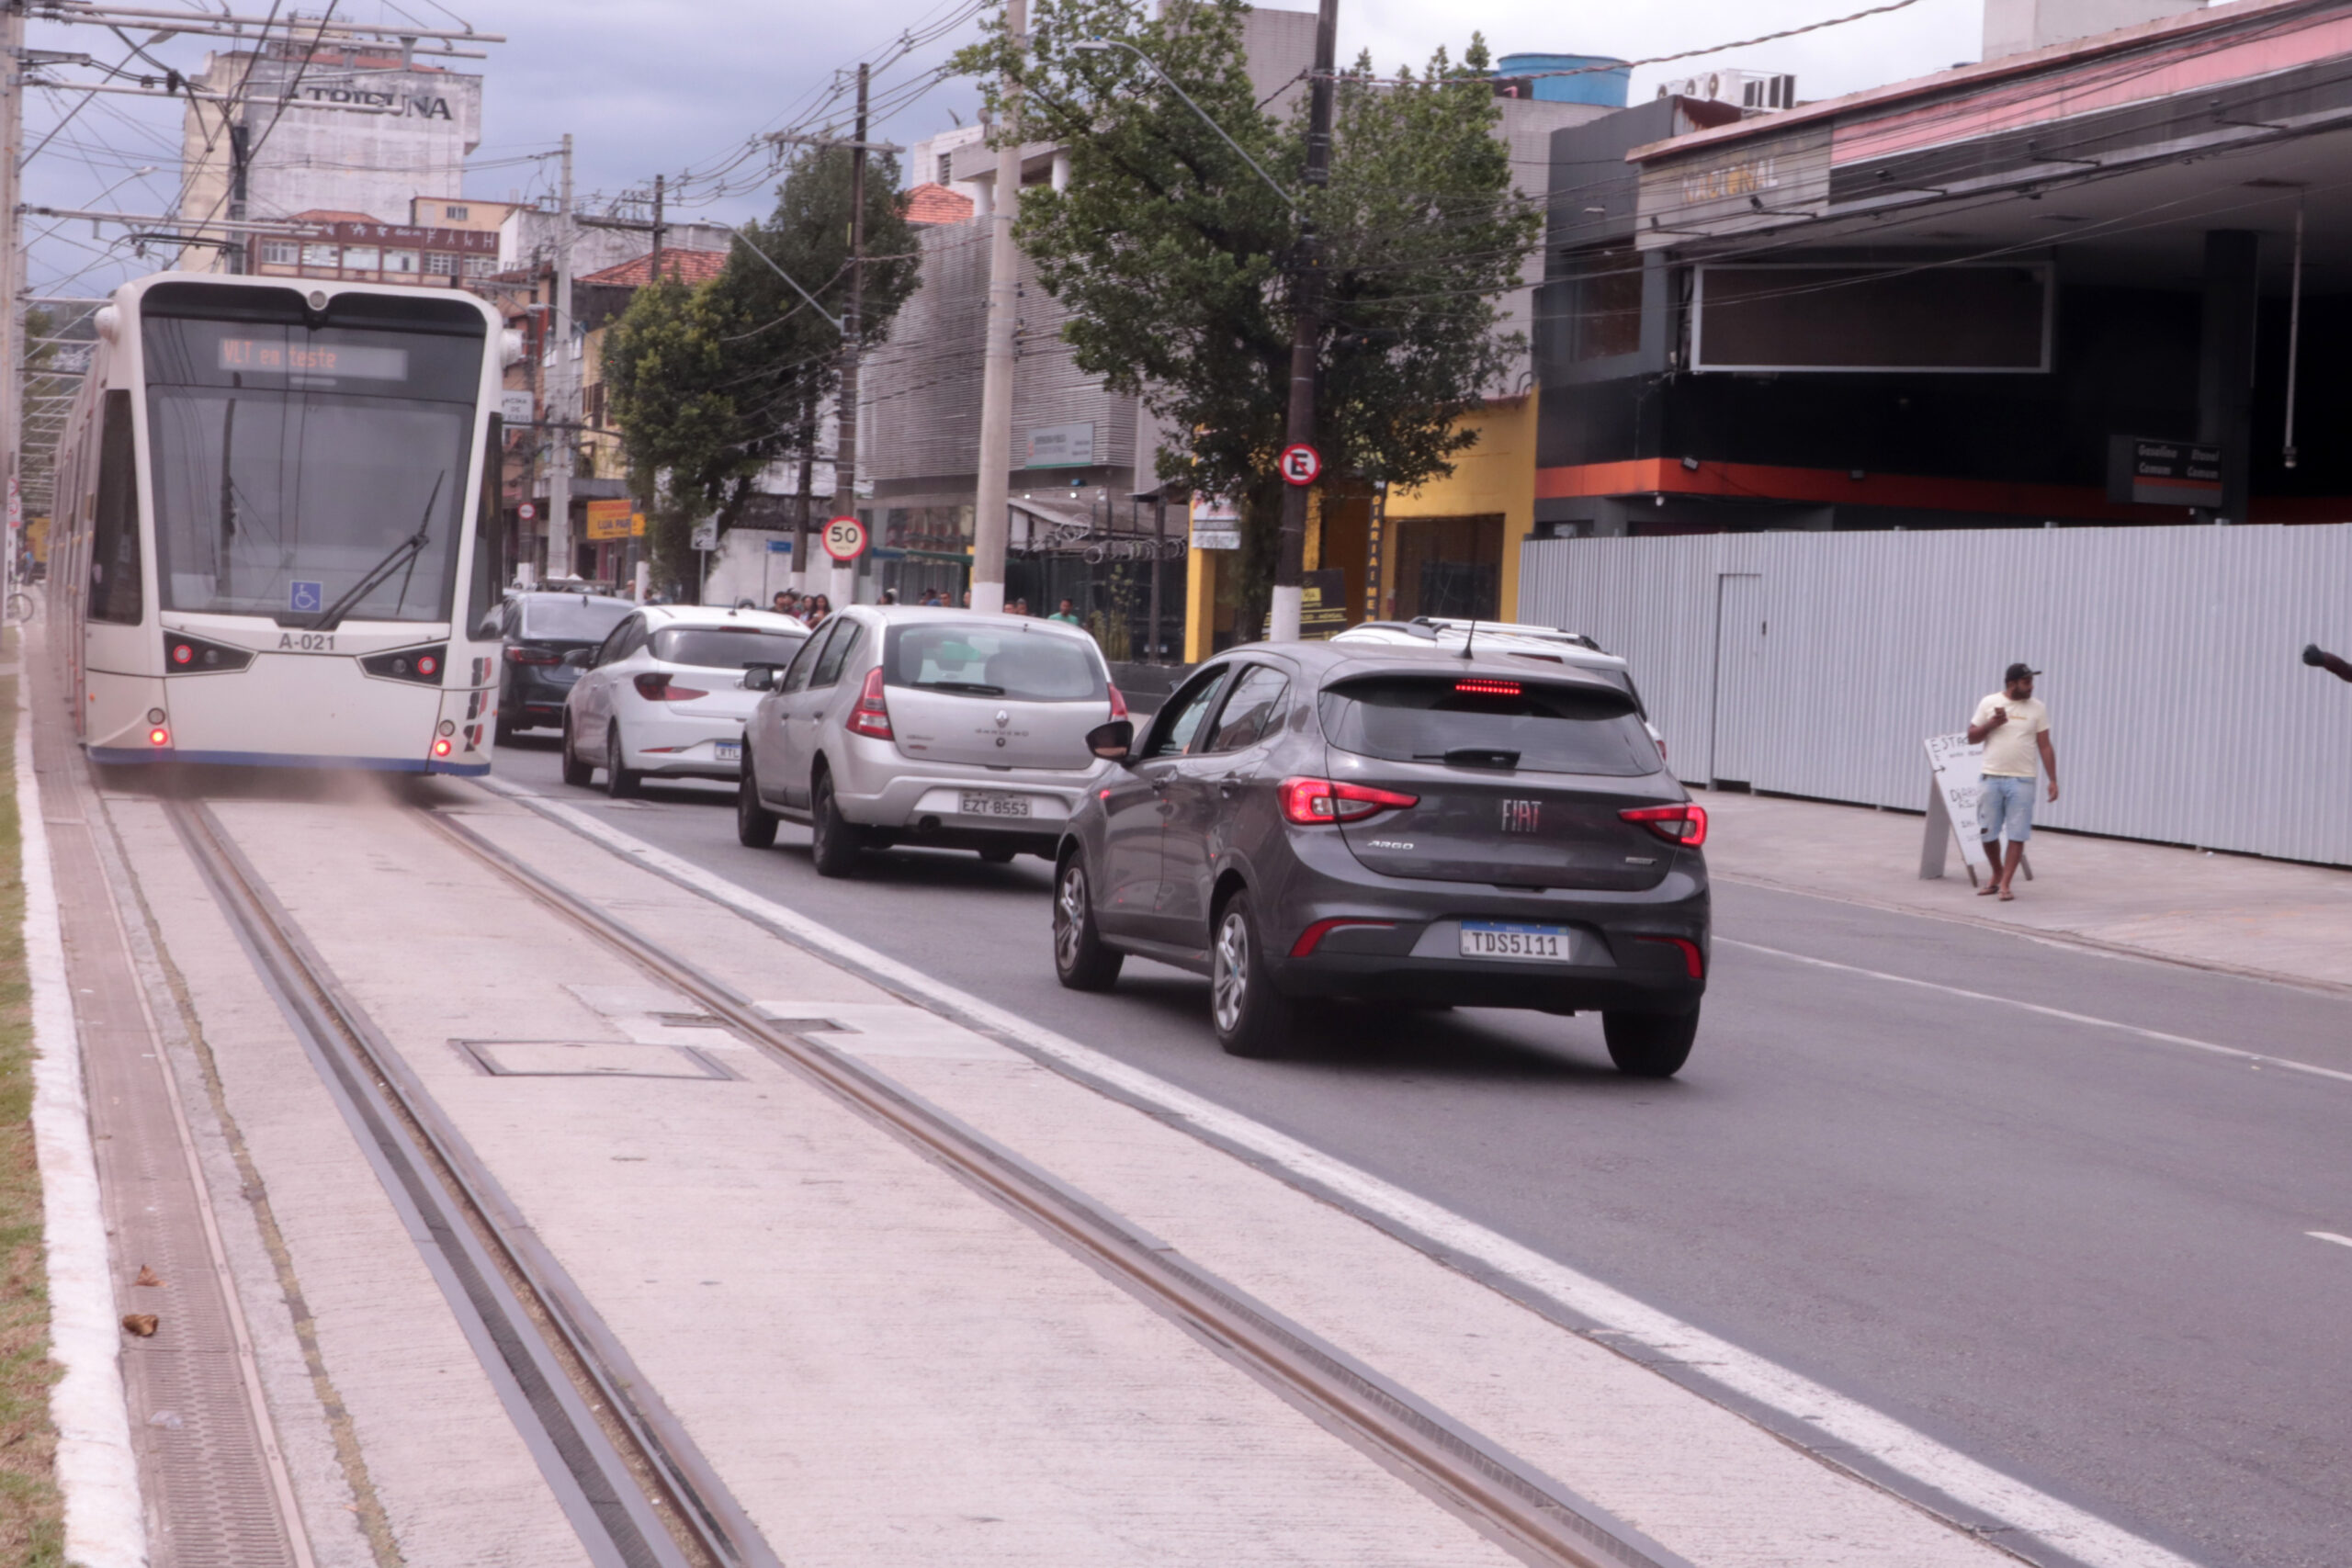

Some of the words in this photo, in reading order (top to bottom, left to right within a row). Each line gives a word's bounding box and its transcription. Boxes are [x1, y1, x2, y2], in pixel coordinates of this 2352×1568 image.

[223, 340, 253, 364] VLT
[288, 345, 337, 368] teste
[1291, 453, 1308, 476] E
[831, 526, 858, 544] 50
[278, 632, 335, 650] A-021
[1501, 798, 1543, 831] FIAT
[1367, 840, 1415, 851] ARGO
